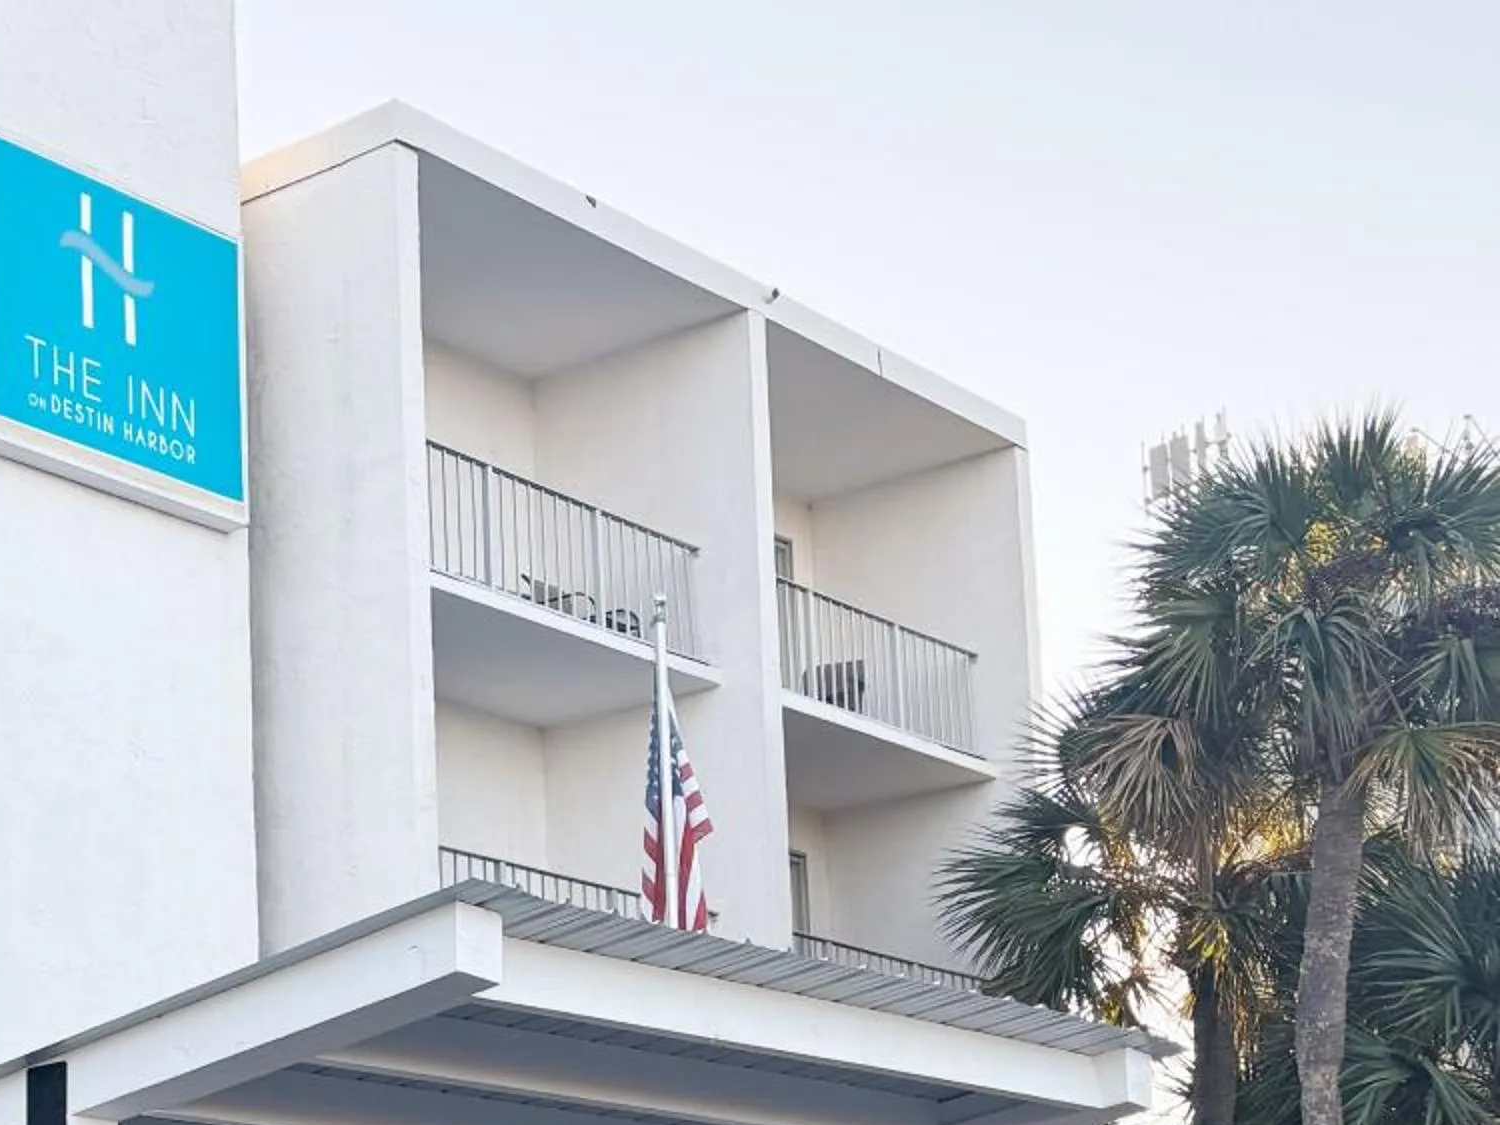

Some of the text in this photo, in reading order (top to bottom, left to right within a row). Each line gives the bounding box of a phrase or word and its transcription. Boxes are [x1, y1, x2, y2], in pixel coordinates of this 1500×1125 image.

[24, 334, 195, 438] THE INN
[28, 393, 196, 464] ON DESTIN HARBOR
